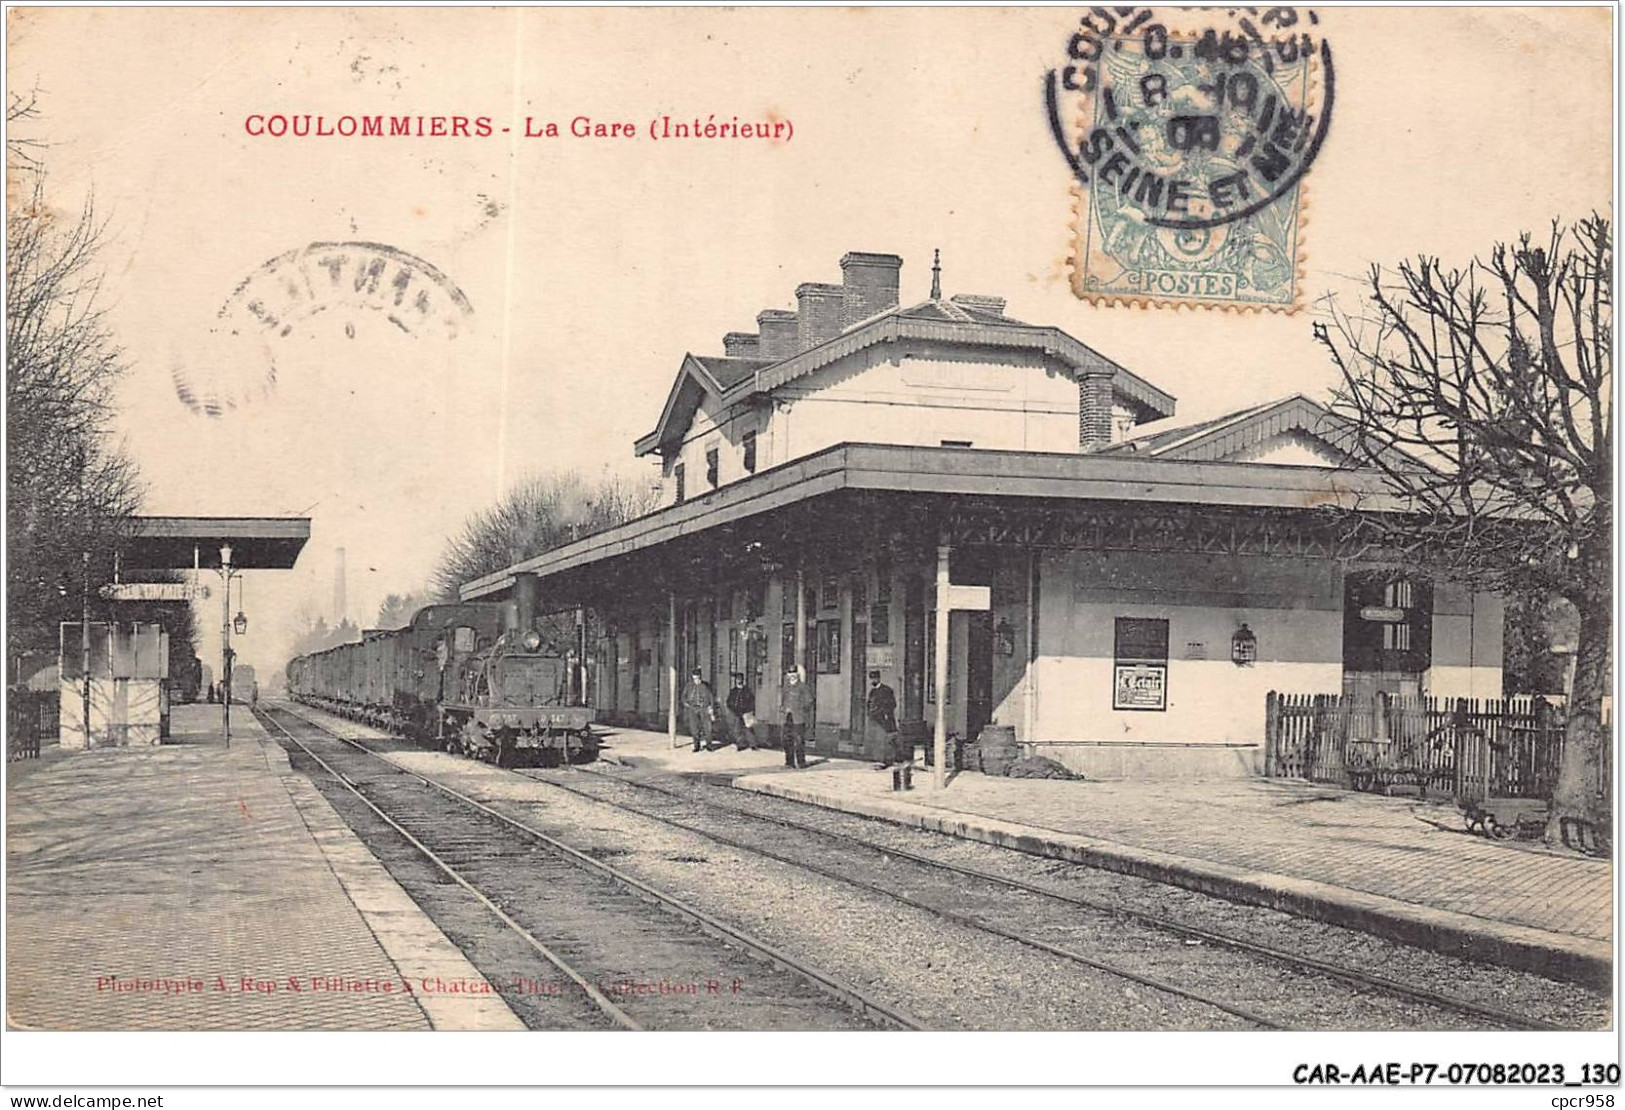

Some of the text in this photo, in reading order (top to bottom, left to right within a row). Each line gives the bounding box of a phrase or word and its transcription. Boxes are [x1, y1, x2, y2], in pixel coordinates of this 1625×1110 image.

[244, 114, 493, 138] COULOMMIERS
[525, 116, 559, 138] La
[570, 116, 637, 138] Gare
[649, 115, 794, 141] (Intérieur)
[1080, 128, 1190, 211] SEINE
[1208, 169, 1249, 208] ET
[1141, 272, 1234, 297] POSTES
[96, 976, 204, 996] Phototypie
[241, 977, 277, 995] Rep
[286, 976, 303, 993] &
